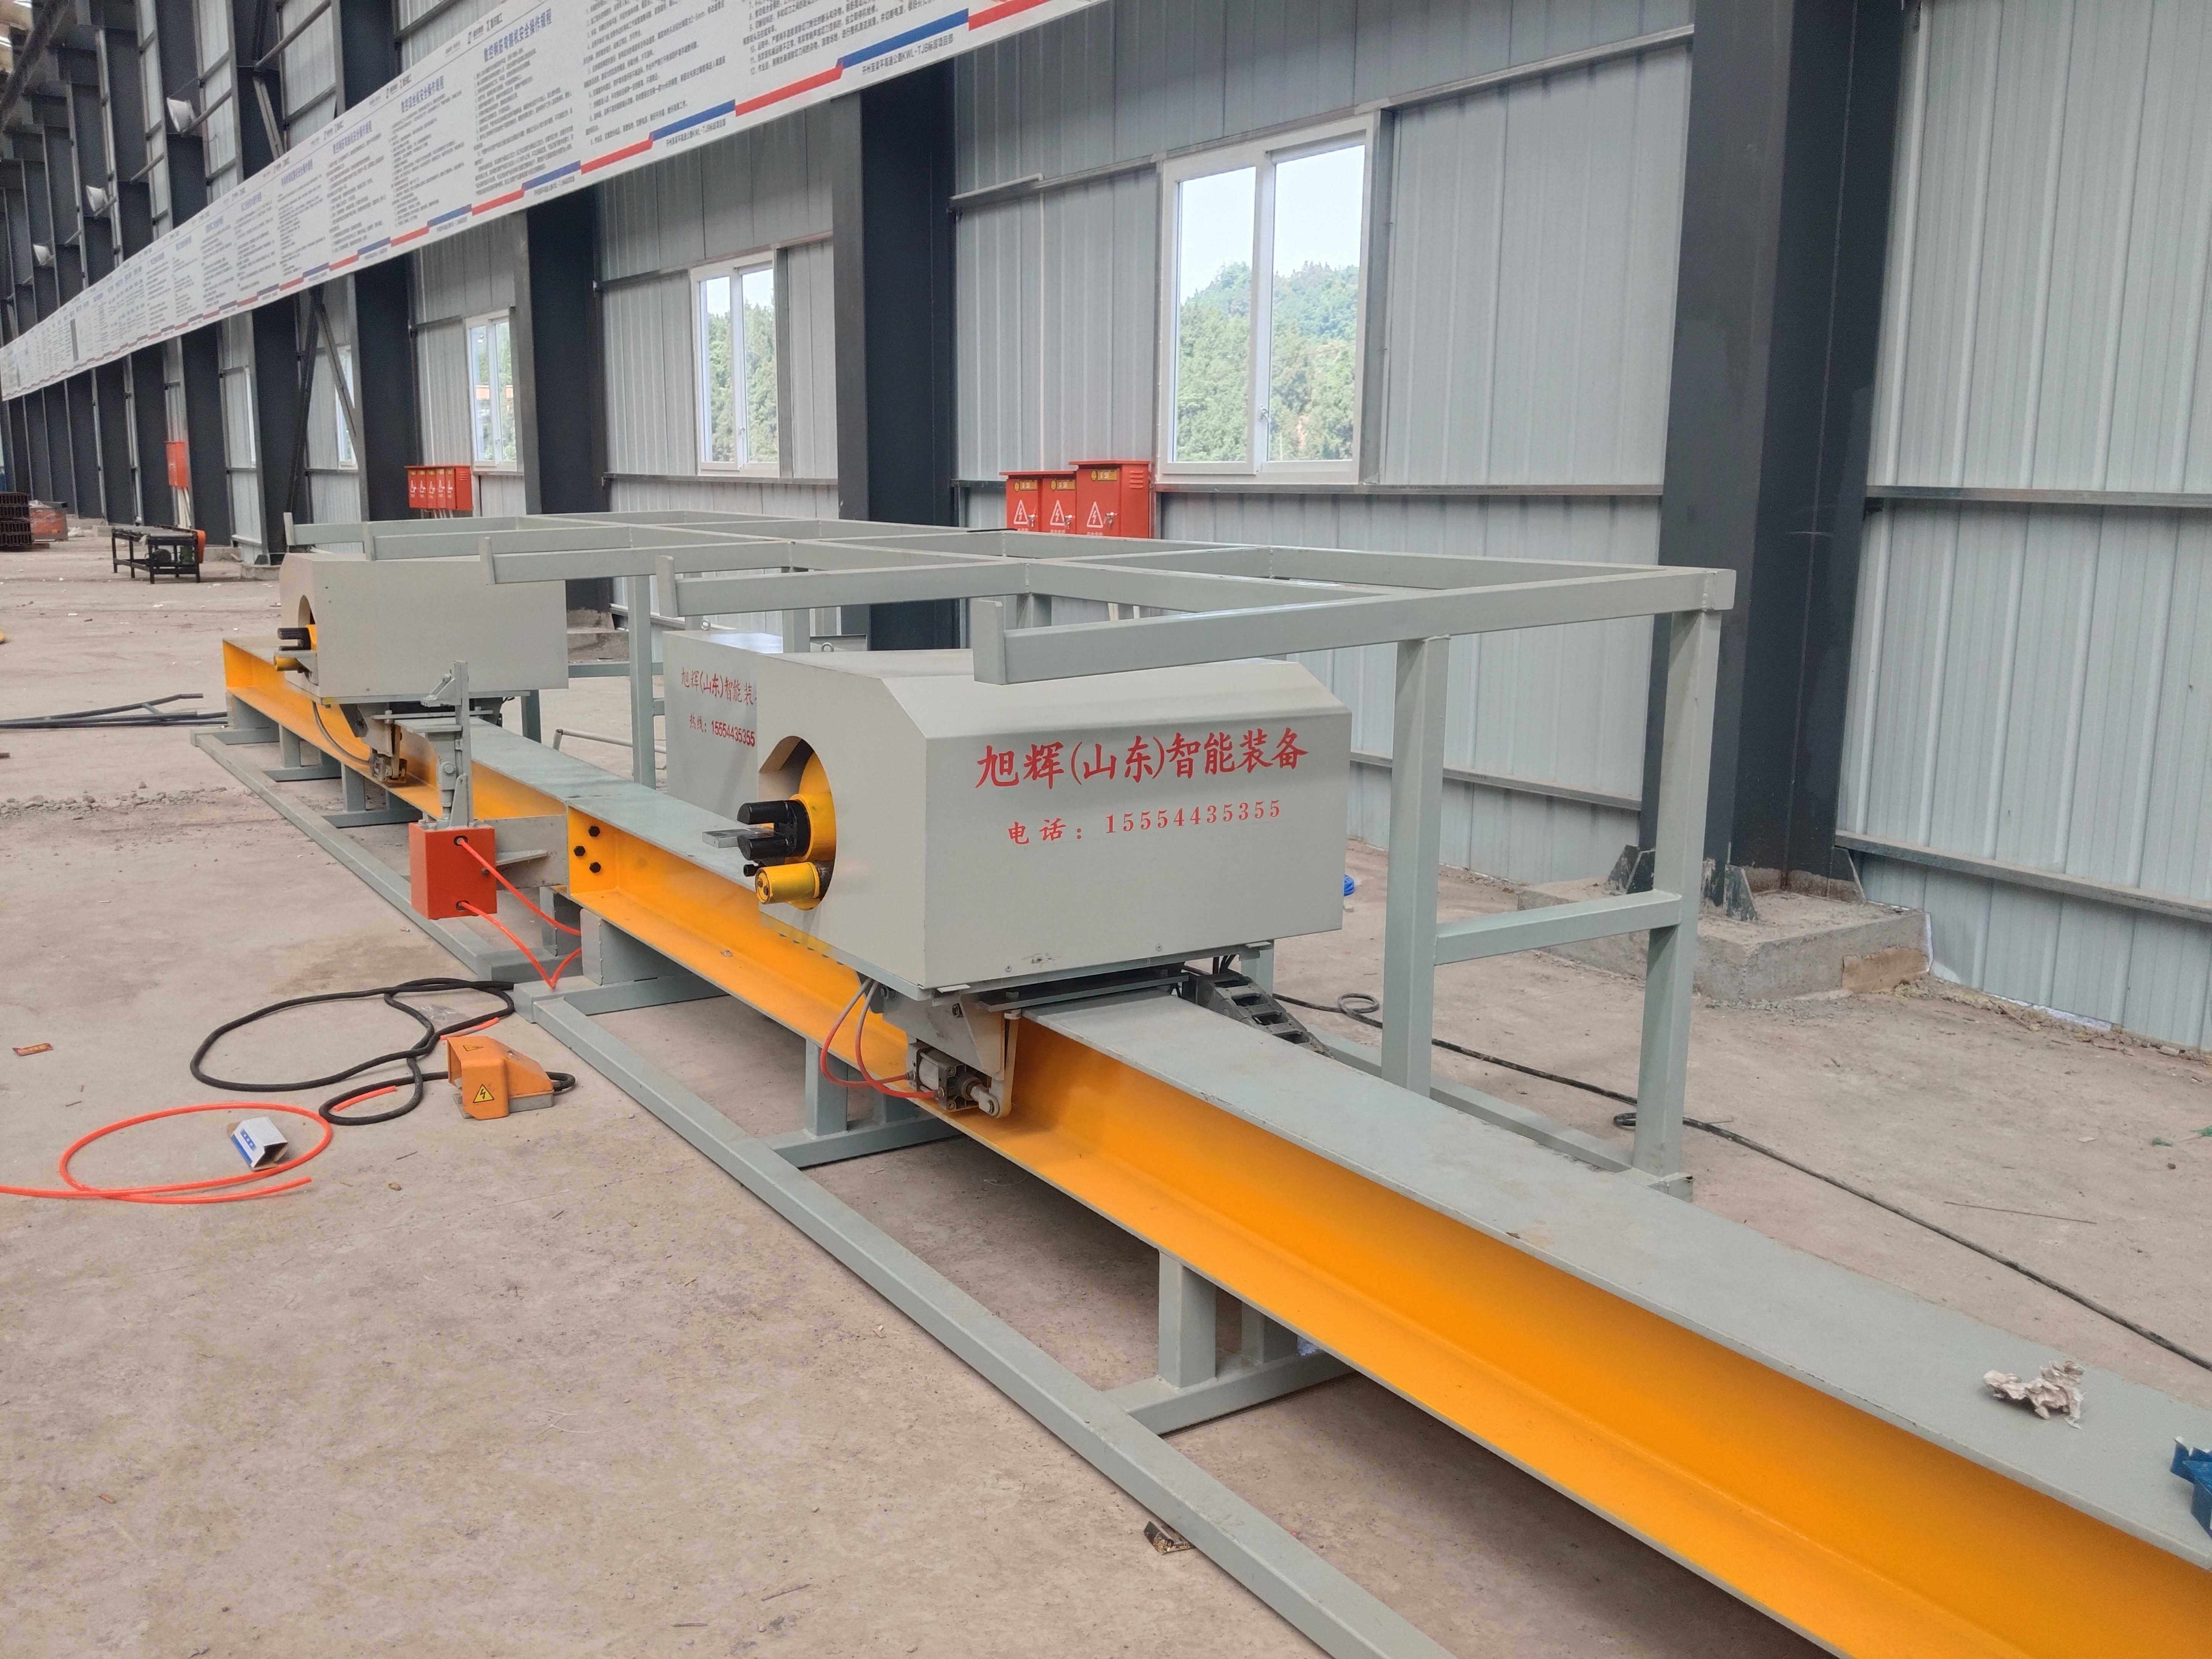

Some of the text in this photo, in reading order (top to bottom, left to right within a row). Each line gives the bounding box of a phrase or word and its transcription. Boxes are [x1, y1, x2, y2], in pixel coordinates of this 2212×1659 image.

[681, 667, 757, 706] 旭辉(山东)智能装
[711, 720, 755, 747] 15554435355
[975, 728, 1308, 789] 旭辉(山东)智能装备
[1105, 799, 1280, 834] 15554435355
